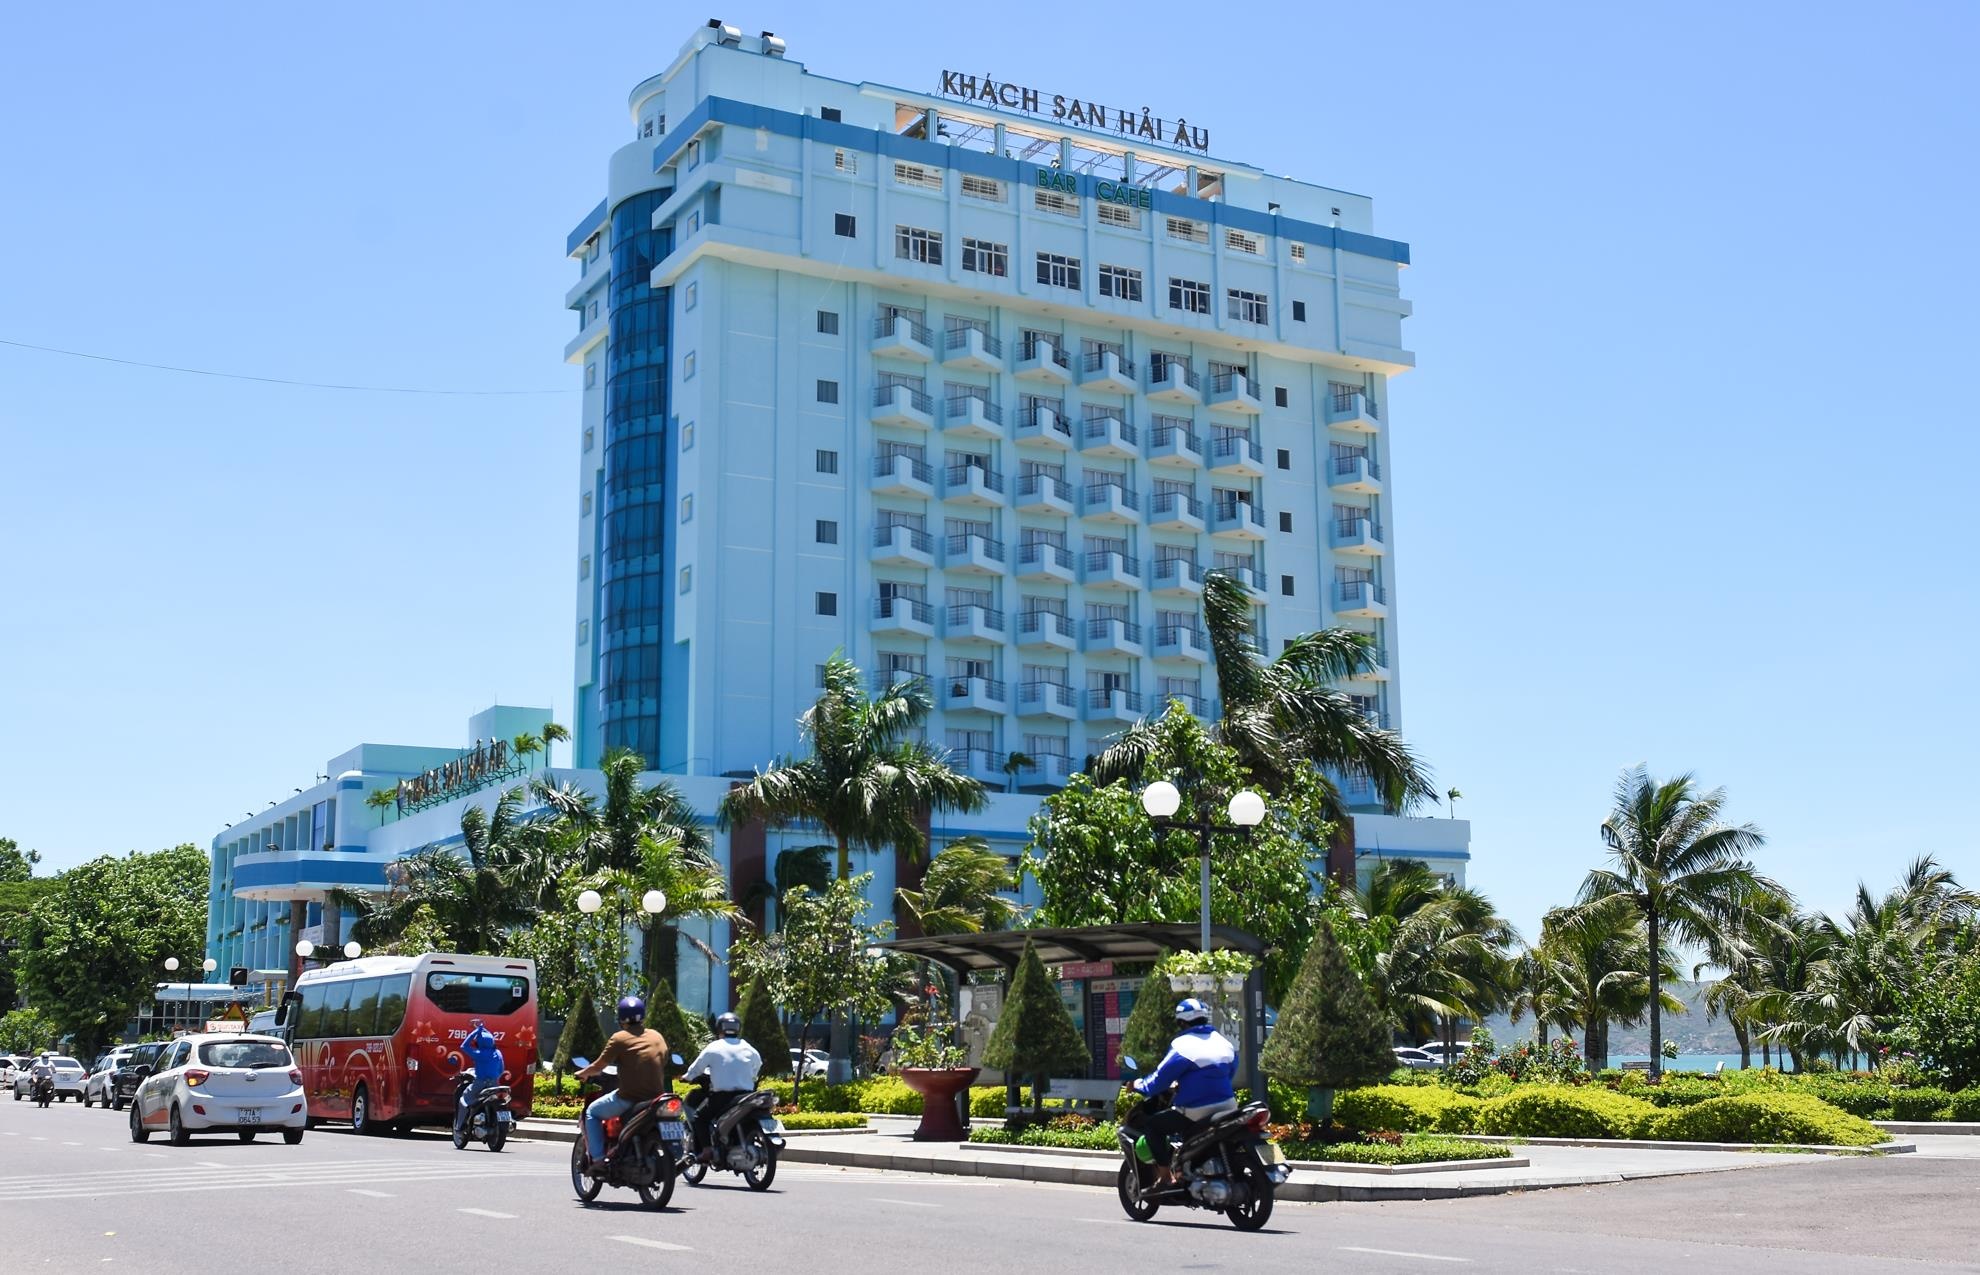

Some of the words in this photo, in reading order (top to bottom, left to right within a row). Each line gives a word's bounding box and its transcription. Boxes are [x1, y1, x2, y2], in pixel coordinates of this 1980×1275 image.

[942, 69, 1038, 113] KHÁCH
[1052, 94, 1106, 128] SẠN
[1119, 106, 1162, 140] HẢI
[1173, 118, 1209, 150] ÂU
[1036, 168, 1077, 194] BAR
[1096, 180, 1151, 209] CAFÉ
